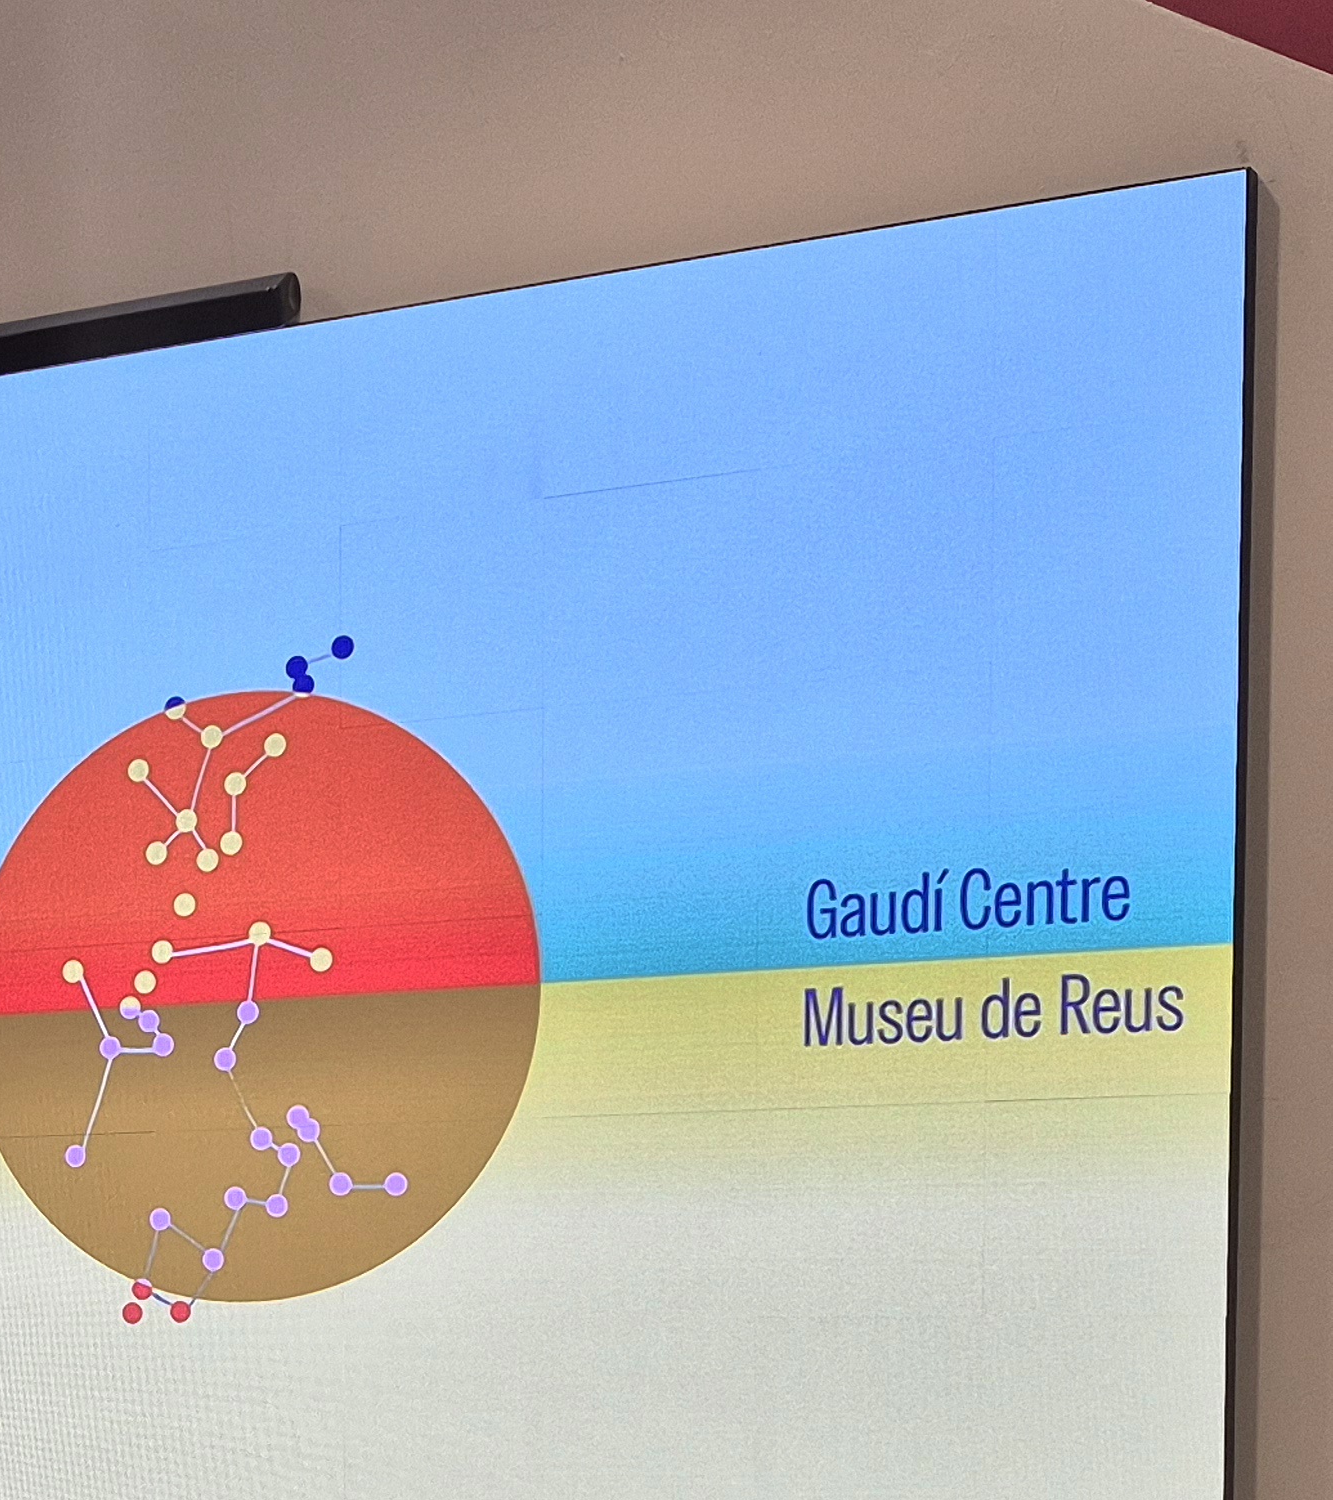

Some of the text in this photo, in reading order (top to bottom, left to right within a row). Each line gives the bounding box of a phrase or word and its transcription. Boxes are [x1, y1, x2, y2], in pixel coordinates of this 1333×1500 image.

[806, 867, 1131, 940] Gaudí Centre
[803, 973, 1185, 1048] Museu de Reus
